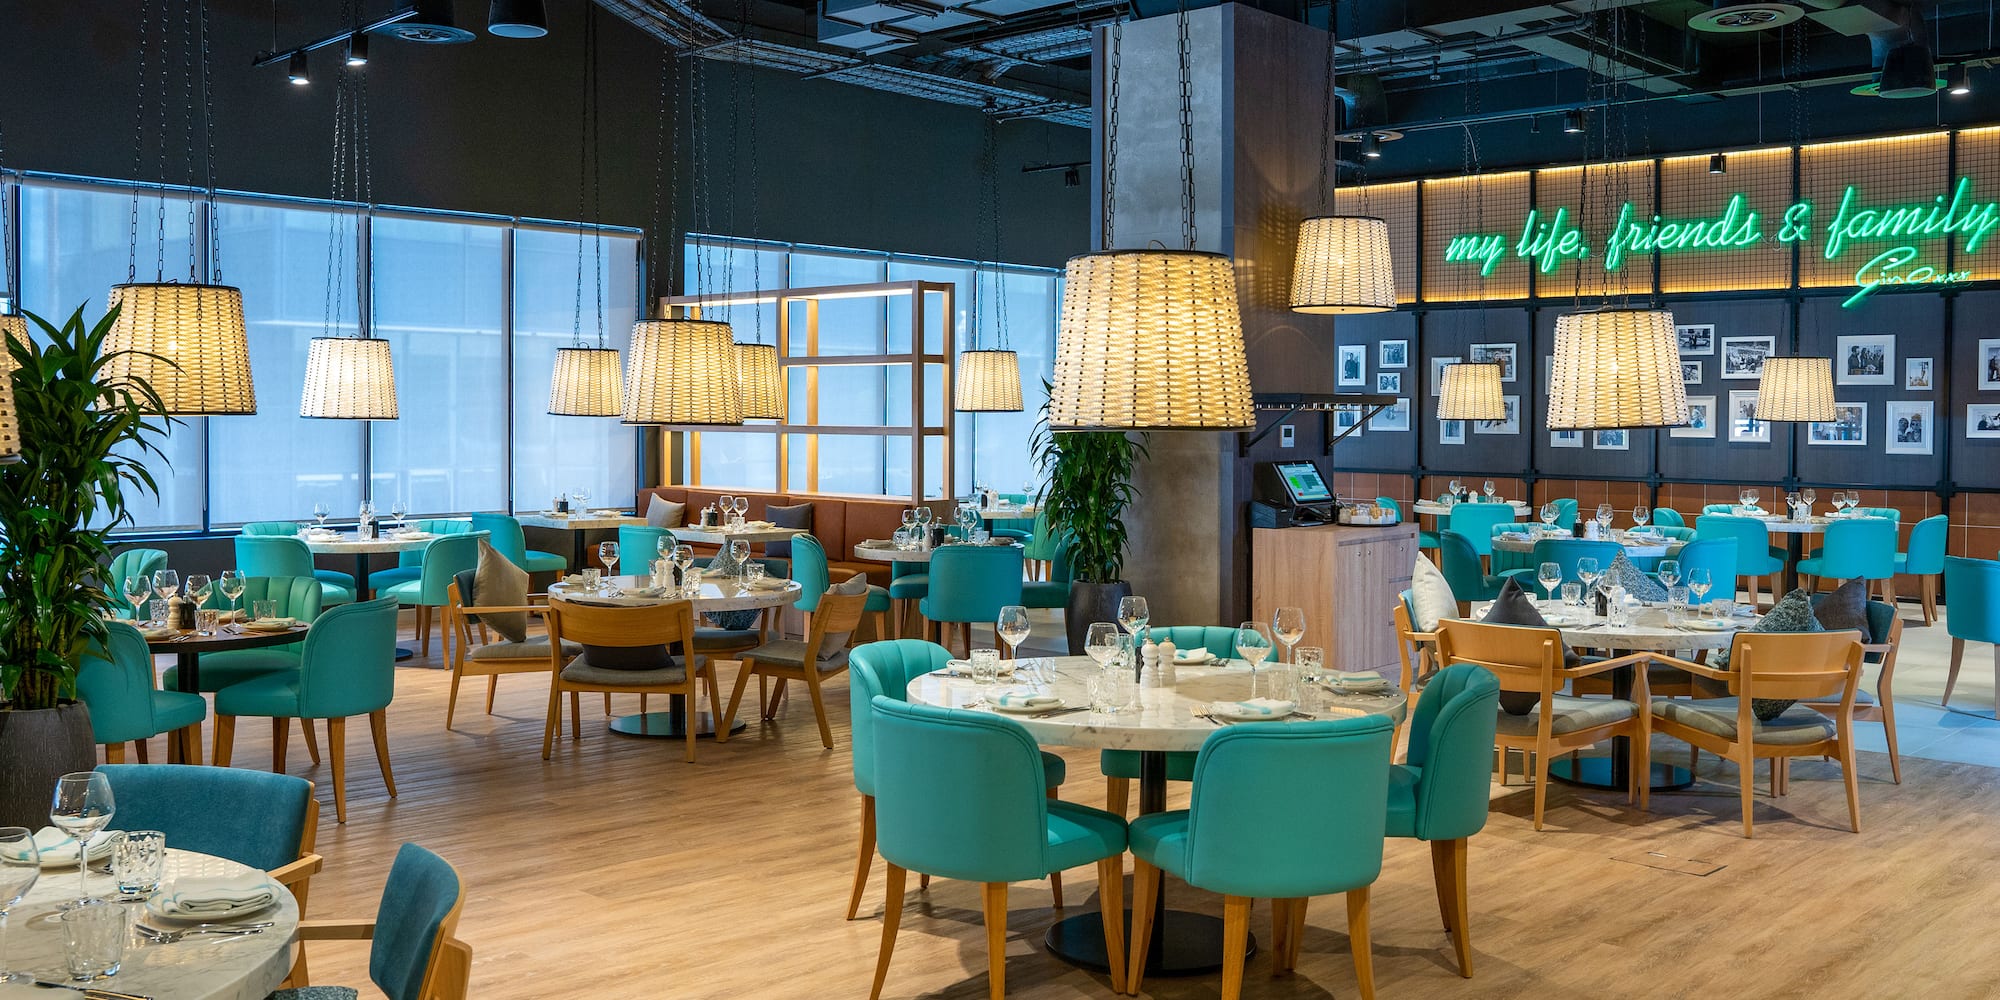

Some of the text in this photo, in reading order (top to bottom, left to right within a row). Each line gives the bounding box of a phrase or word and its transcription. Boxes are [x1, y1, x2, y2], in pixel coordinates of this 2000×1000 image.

[1446, 235, 1504, 276] my
[1605, 194, 1762, 271] friends
[1778, 203, 1811, 243] &
[1825, 176, 2000, 260] family
